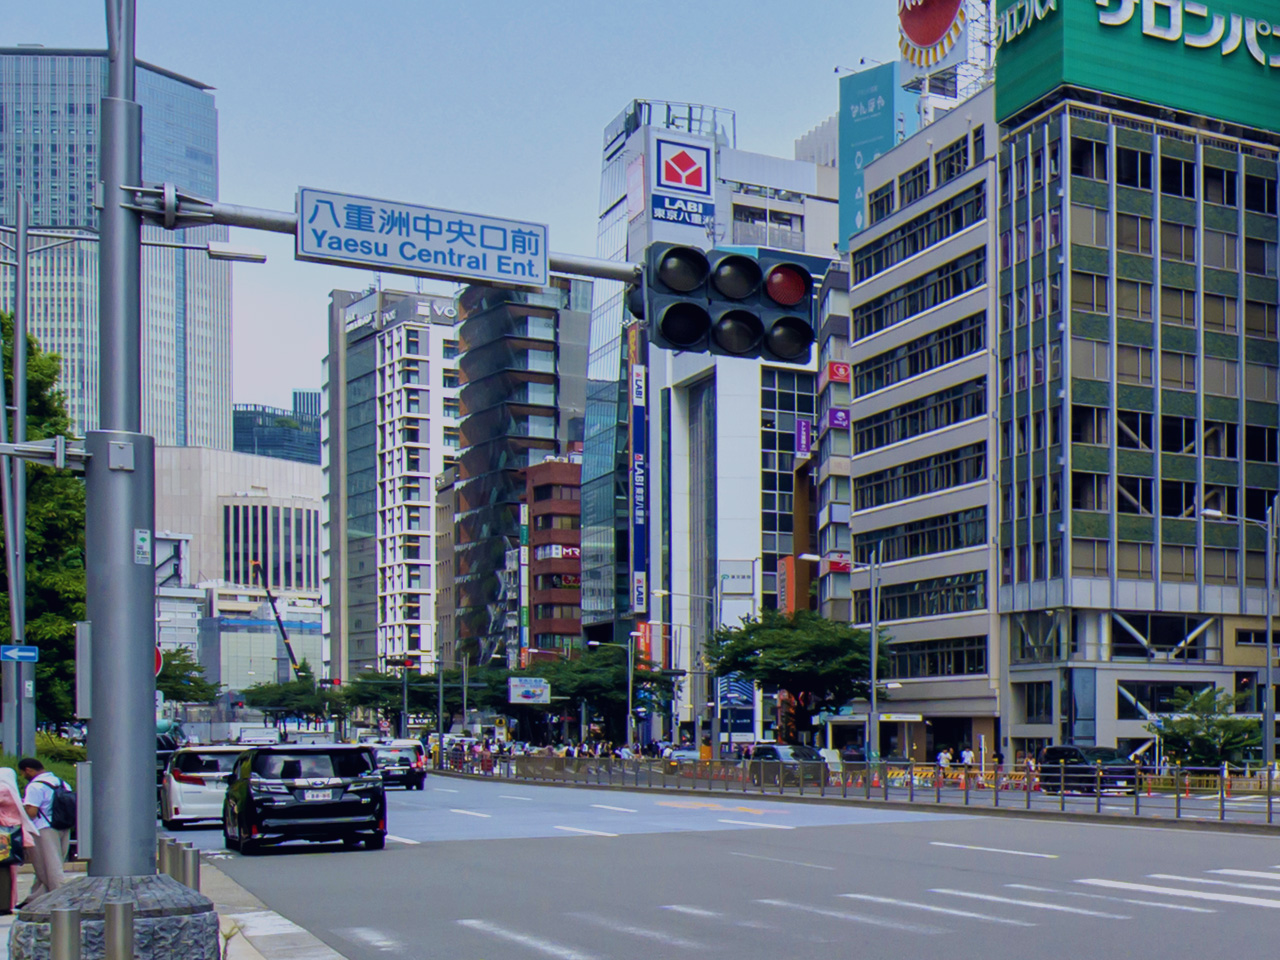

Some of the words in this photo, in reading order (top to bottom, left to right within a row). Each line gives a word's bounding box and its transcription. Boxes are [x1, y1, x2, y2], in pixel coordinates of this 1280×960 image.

[664, 197, 703, 214] LABI
[308, 198, 541, 258] 八重洲中央口前
[311, 228, 388, 258] Yaesu
[398, 240, 488, 272] Central
[496, 254, 540, 279] Ent.
[635, 378, 643, 399] LABI
[635, 461, 645, 488] LABI
[636, 585, 644, 606] LABI
